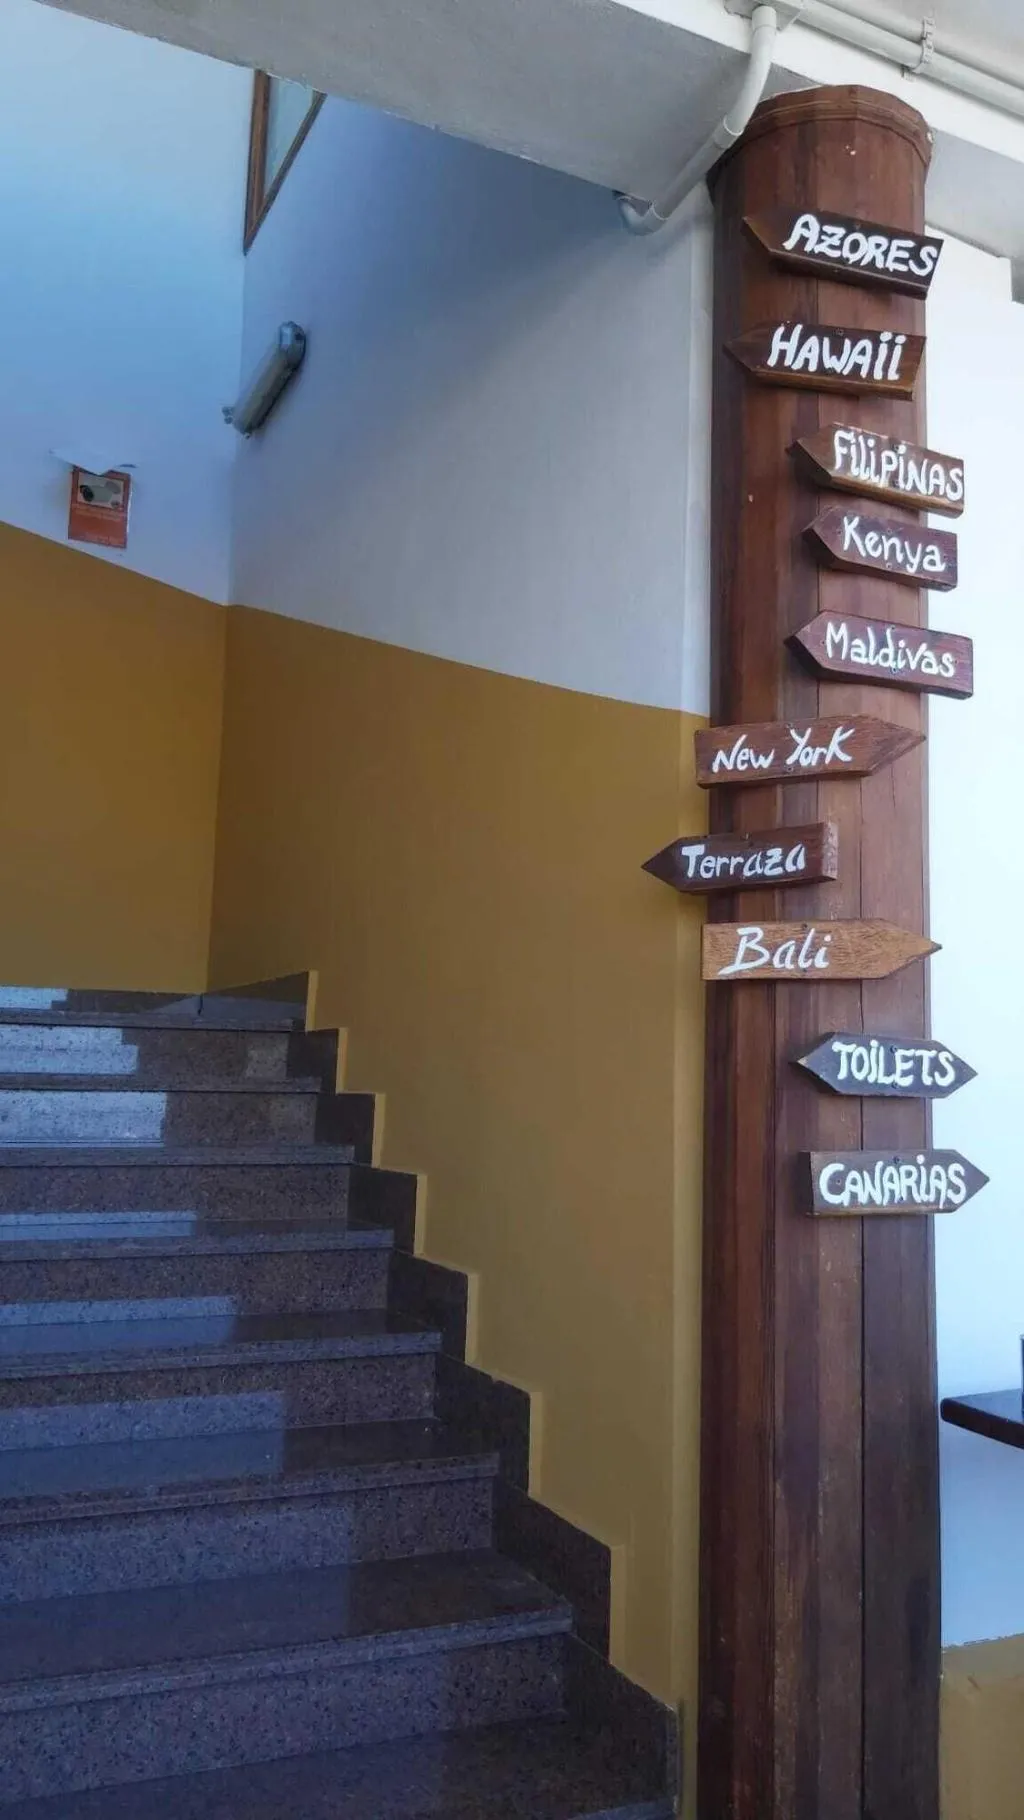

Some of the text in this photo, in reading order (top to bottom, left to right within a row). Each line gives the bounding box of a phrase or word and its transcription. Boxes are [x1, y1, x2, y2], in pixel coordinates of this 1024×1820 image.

[782, 213, 938, 277] AZORES
[842, 515, 947, 576] Kenya
[824, 620, 957, 679] Maldivas
[712, 734, 776, 773] New
[681, 844, 806, 879] Terraza
[717, 925, 832, 976] Bali
